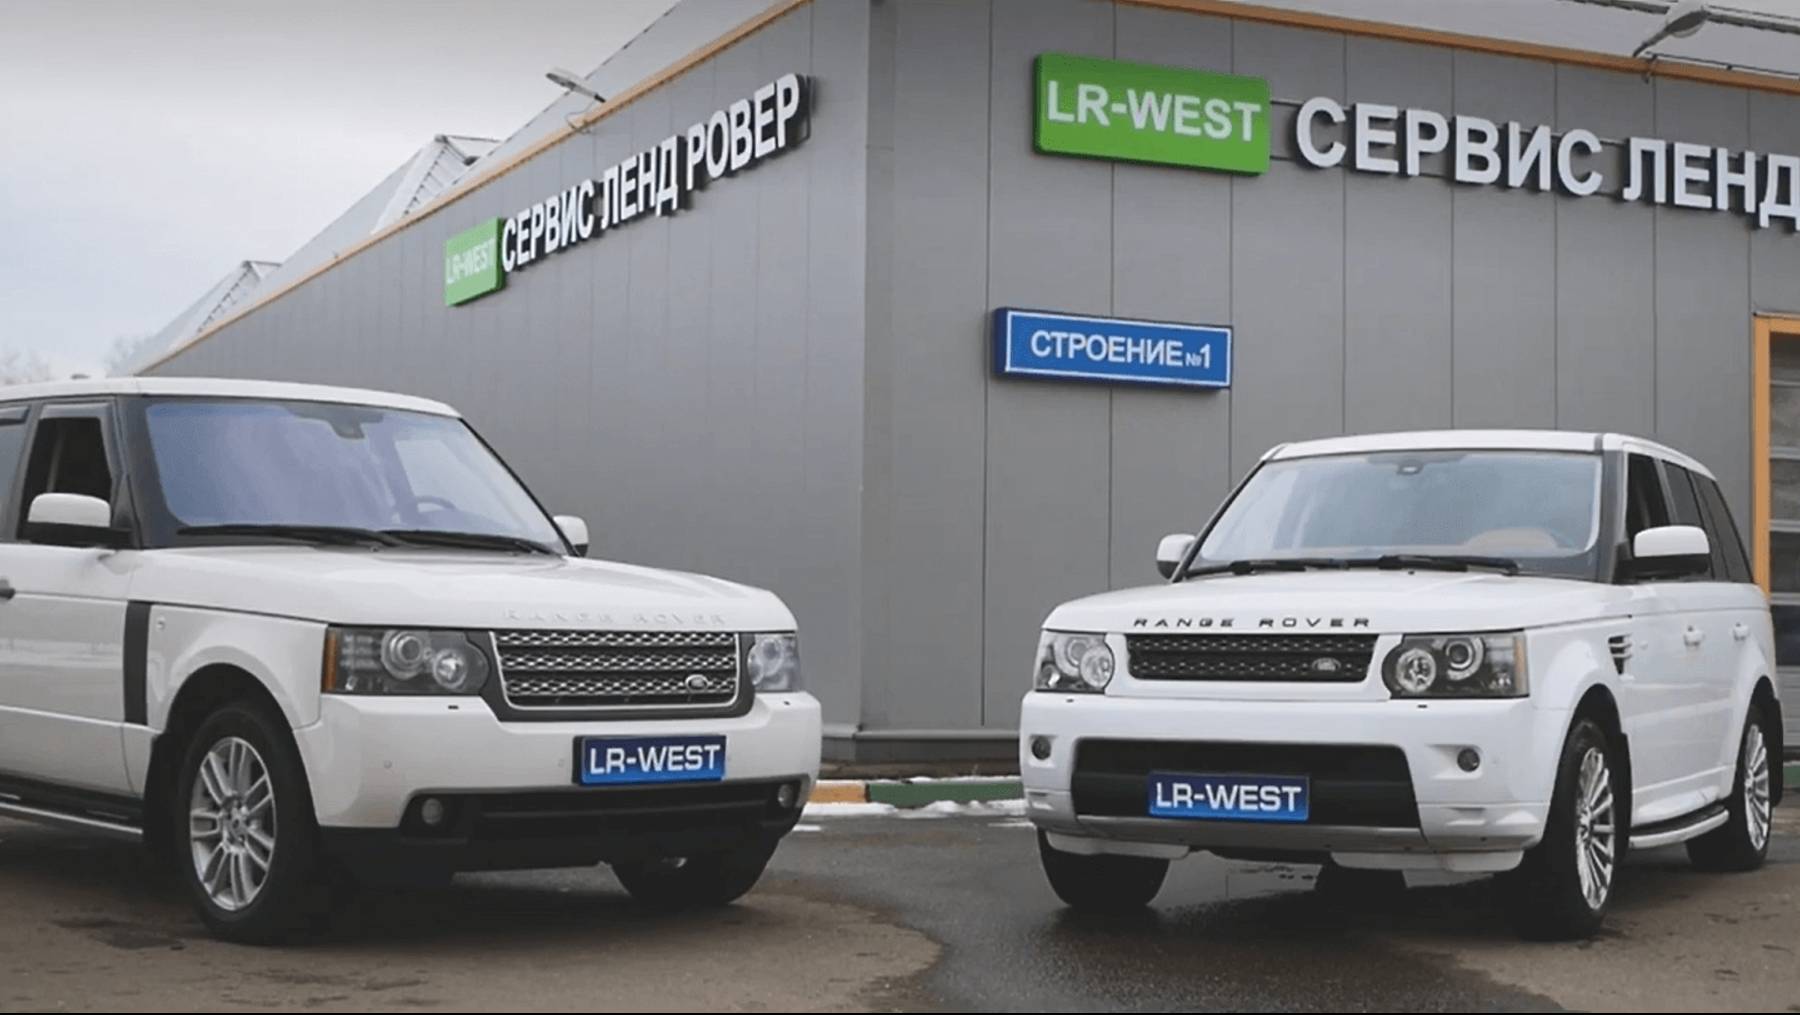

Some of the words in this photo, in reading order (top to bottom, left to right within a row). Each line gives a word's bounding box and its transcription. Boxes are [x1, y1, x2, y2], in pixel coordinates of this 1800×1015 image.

[1047, 80, 1261, 142] LR-WEST
[502, 178, 595, 272] СЕРВИС
[600, 134, 678, 230] ЛЕНД
[686, 73, 801, 190] РОВЕР
[1296, 97, 1603, 196] СЕРВИС
[1623, 136, 1800, 231] ЛЕНД
[446, 238, 496, 284] LR-WEST
[1031, 330, 1183, 367] СТРОЕНИЕ
[1133, 618, 1235, 628] RANGE
[1259, 618, 1370, 628] ROVER
[590, 745, 721, 774] LR-WEST
[1156, 783, 1302, 812] LR-WEST
